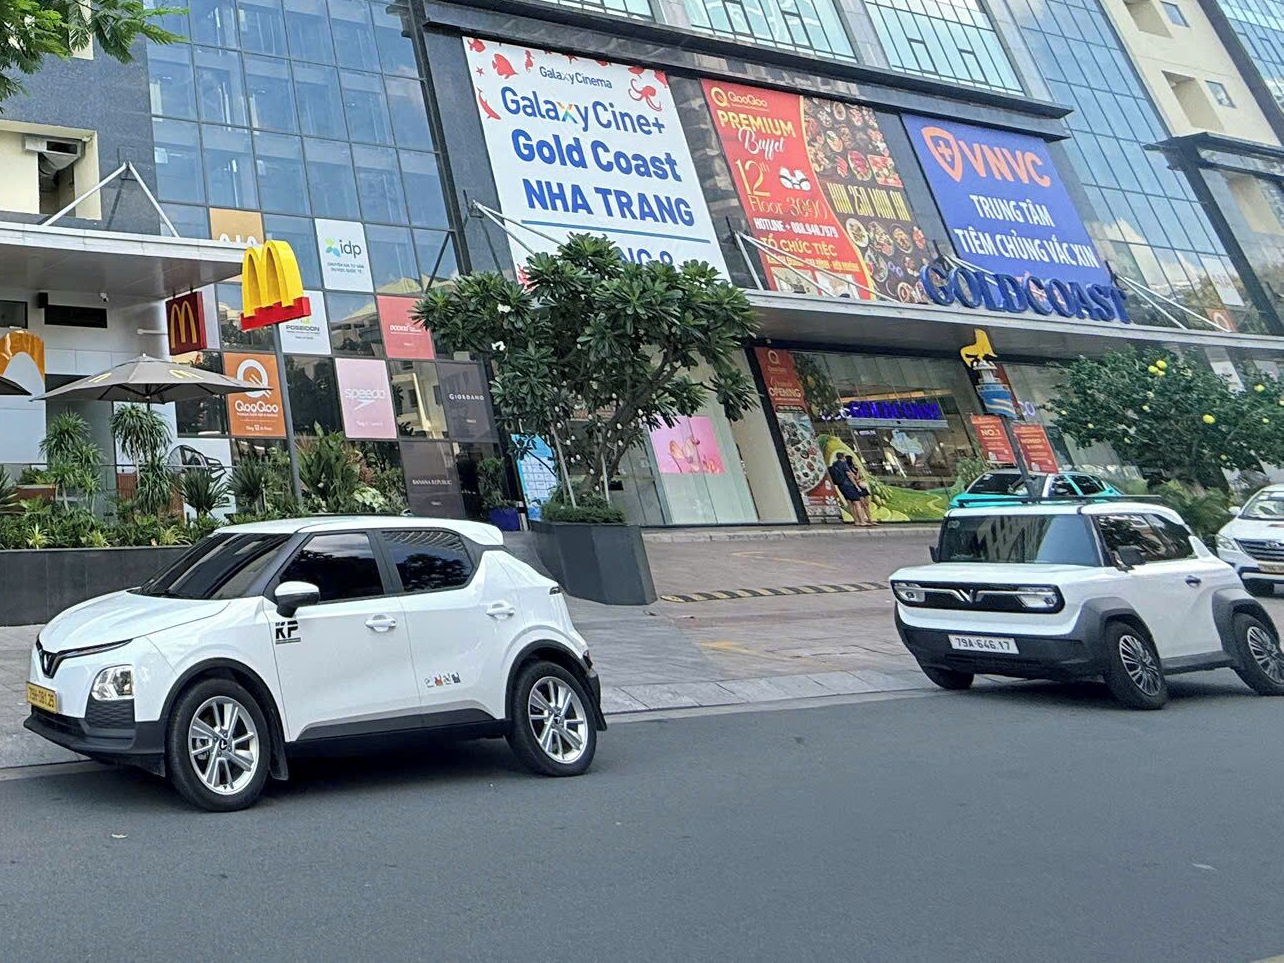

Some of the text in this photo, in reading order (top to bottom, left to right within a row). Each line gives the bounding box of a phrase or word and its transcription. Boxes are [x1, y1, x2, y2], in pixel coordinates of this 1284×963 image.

[539, 65, 613, 89] Galaxy Cinema
[500, 86, 666, 136] Galaxy Cine+
[716, 109, 797, 138] PREMIUM
[511, 128, 682, 182] Gold Coast
[958, 140, 1052, 188] VNVC
[522, 178, 694, 227] NHA TRANG
[969, 194, 1056, 228] TRUNG TÂM
[753, 217, 786, 232] HOTLINE
[339, 239, 362, 259] idp
[953, 225, 999, 257] TIÊM
[995, 229, 1050, 263] CHỦNG
[1069, 243, 1101, 269] XIN
[345, 388, 386, 400] speedo
[448, 393, 485, 401] GIORDANO
[768, 387, 802, 398] OPENING
[235, 400, 279, 413] QooQoo
